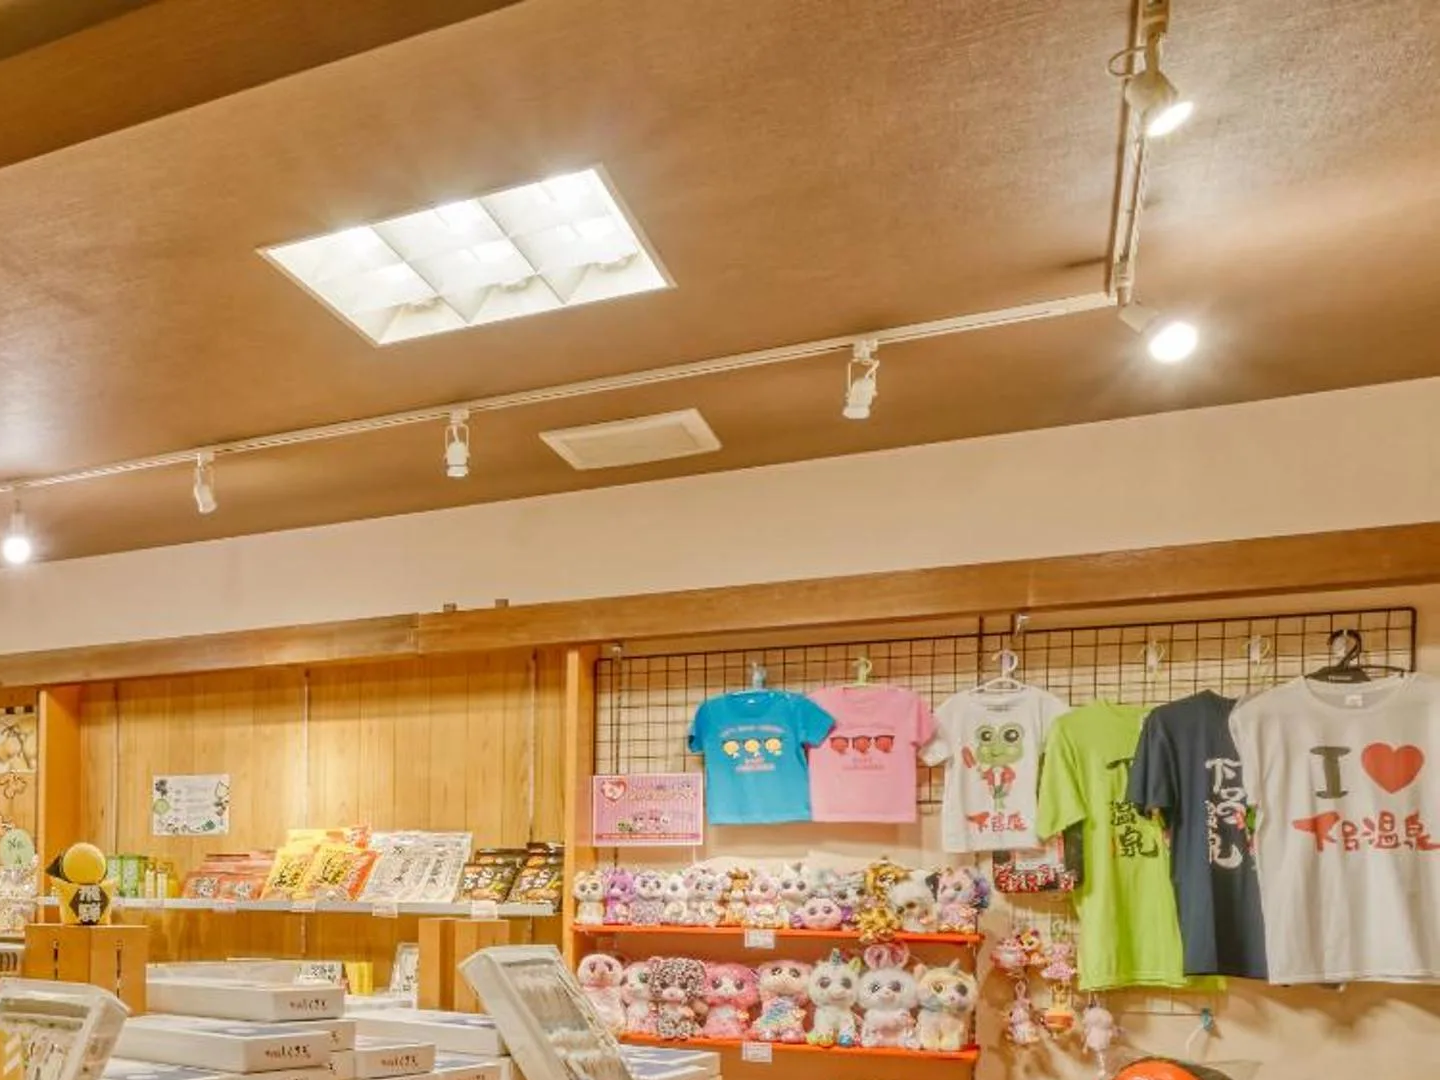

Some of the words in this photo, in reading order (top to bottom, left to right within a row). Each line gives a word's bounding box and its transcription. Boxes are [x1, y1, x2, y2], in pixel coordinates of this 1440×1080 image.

[1310, 746, 1351, 799] I
[1292, 808, 1440, 852] 下呂温泉
